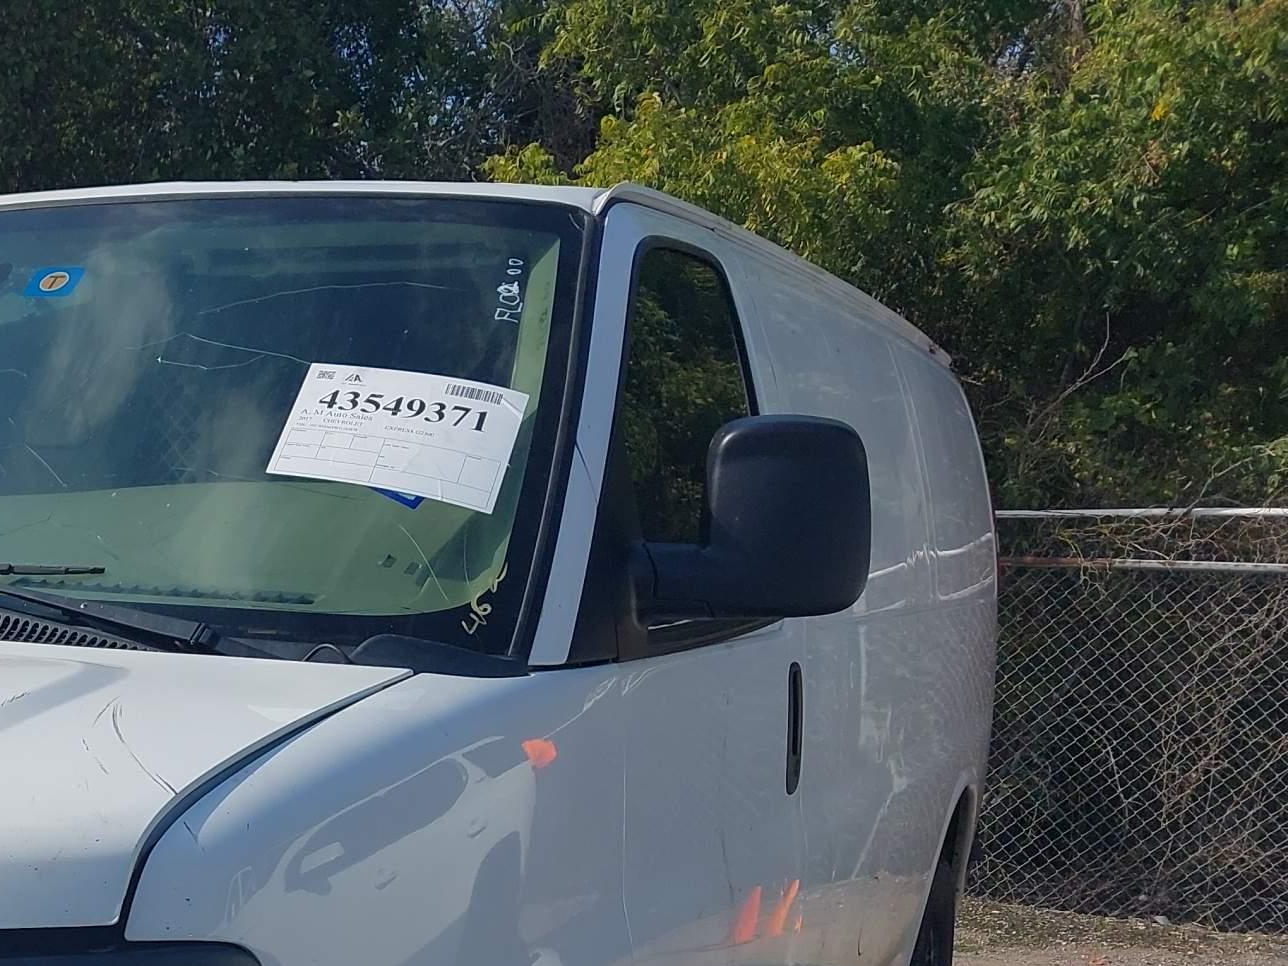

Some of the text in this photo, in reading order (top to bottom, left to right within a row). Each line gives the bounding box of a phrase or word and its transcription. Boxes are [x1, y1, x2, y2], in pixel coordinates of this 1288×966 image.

[318, 389, 489, 433] 43549371
[326, 410, 349, 418] Auto
[349, 412, 374, 421] Sales
